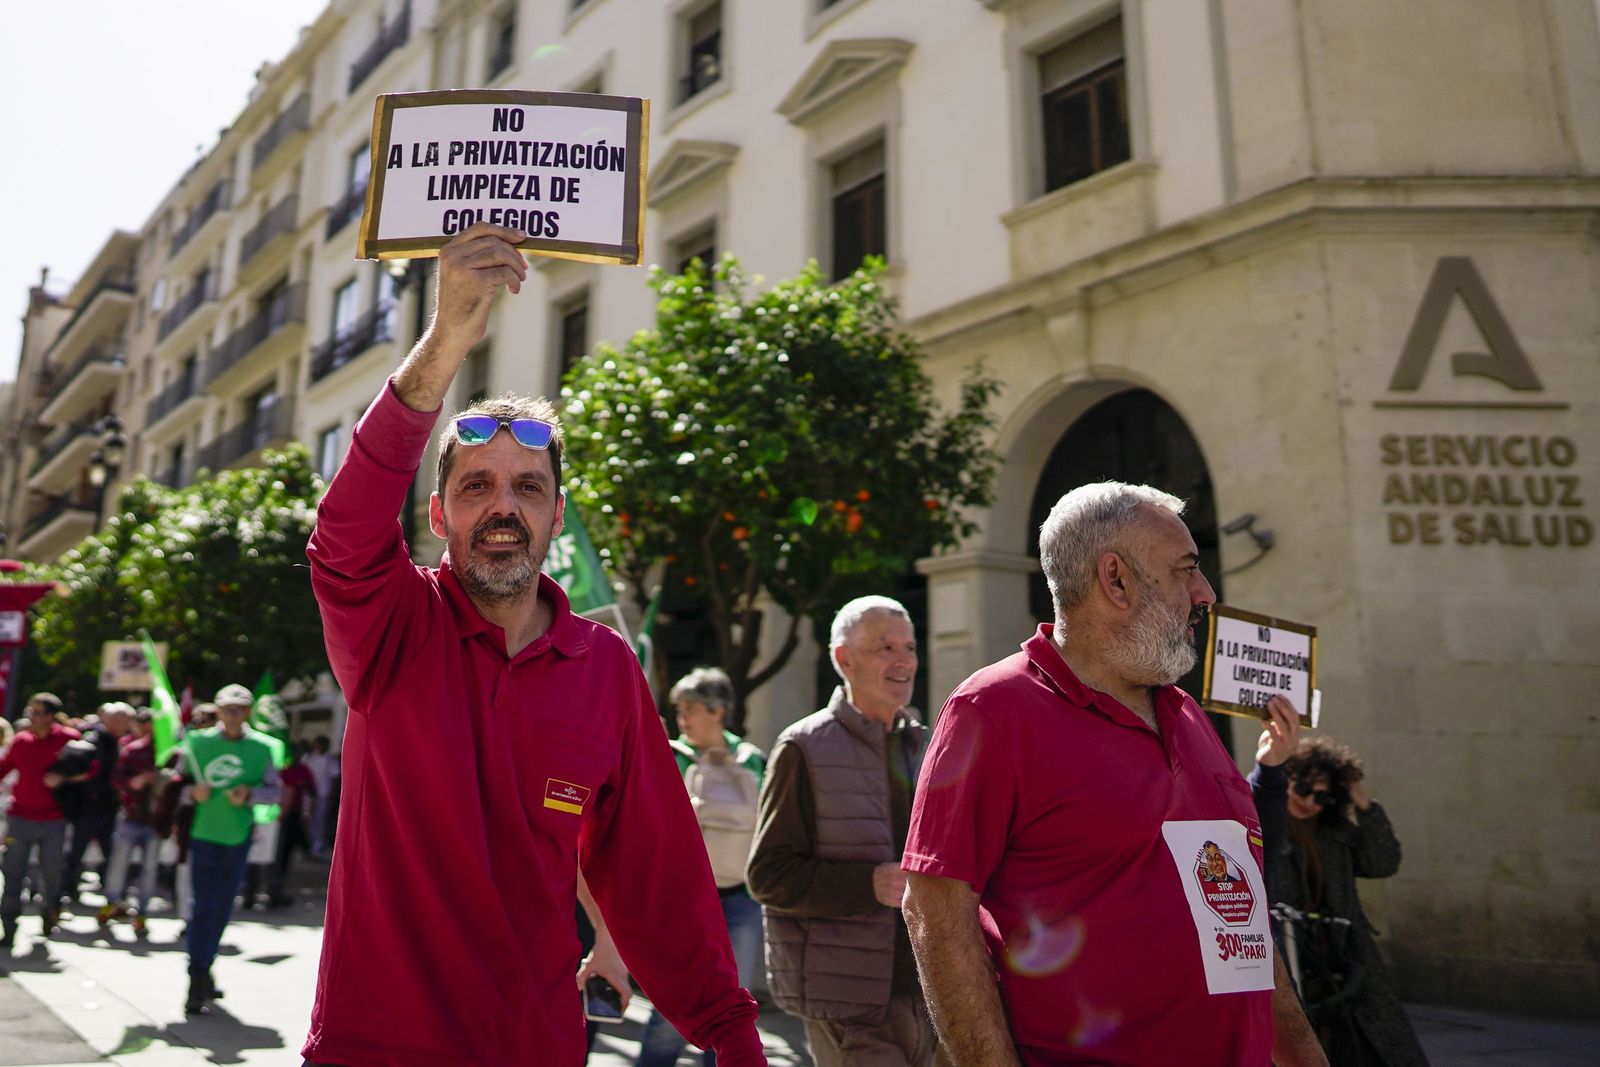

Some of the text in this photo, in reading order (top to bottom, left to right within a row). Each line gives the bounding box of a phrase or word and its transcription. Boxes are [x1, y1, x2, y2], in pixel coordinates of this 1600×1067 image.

[492, 107, 525, 132] NO
[387, 139, 625, 173] A LA PRIVATIZACIÓN
[427, 174, 580, 203] LIMPIEZA DE
[1379, 433, 1578, 467] SERVICIO
[1382, 472, 1584, 507] ANDALUZ
[1387, 512, 1594, 547] DE SALUD
[1257, 626, 1271, 643] NO
[1217, 639, 1309, 673] A LA PRIVATIZACIÓN
[1233, 664, 1292, 691] LIMPIEZA DE
[1207, 891, 1252, 902] PRIVATIZACIÓN
[1217, 882, 1233, 891] STOP
[1216, 932, 1264, 961] 300 FAMILIAS
[1243, 944, 1266, 960] PARO
